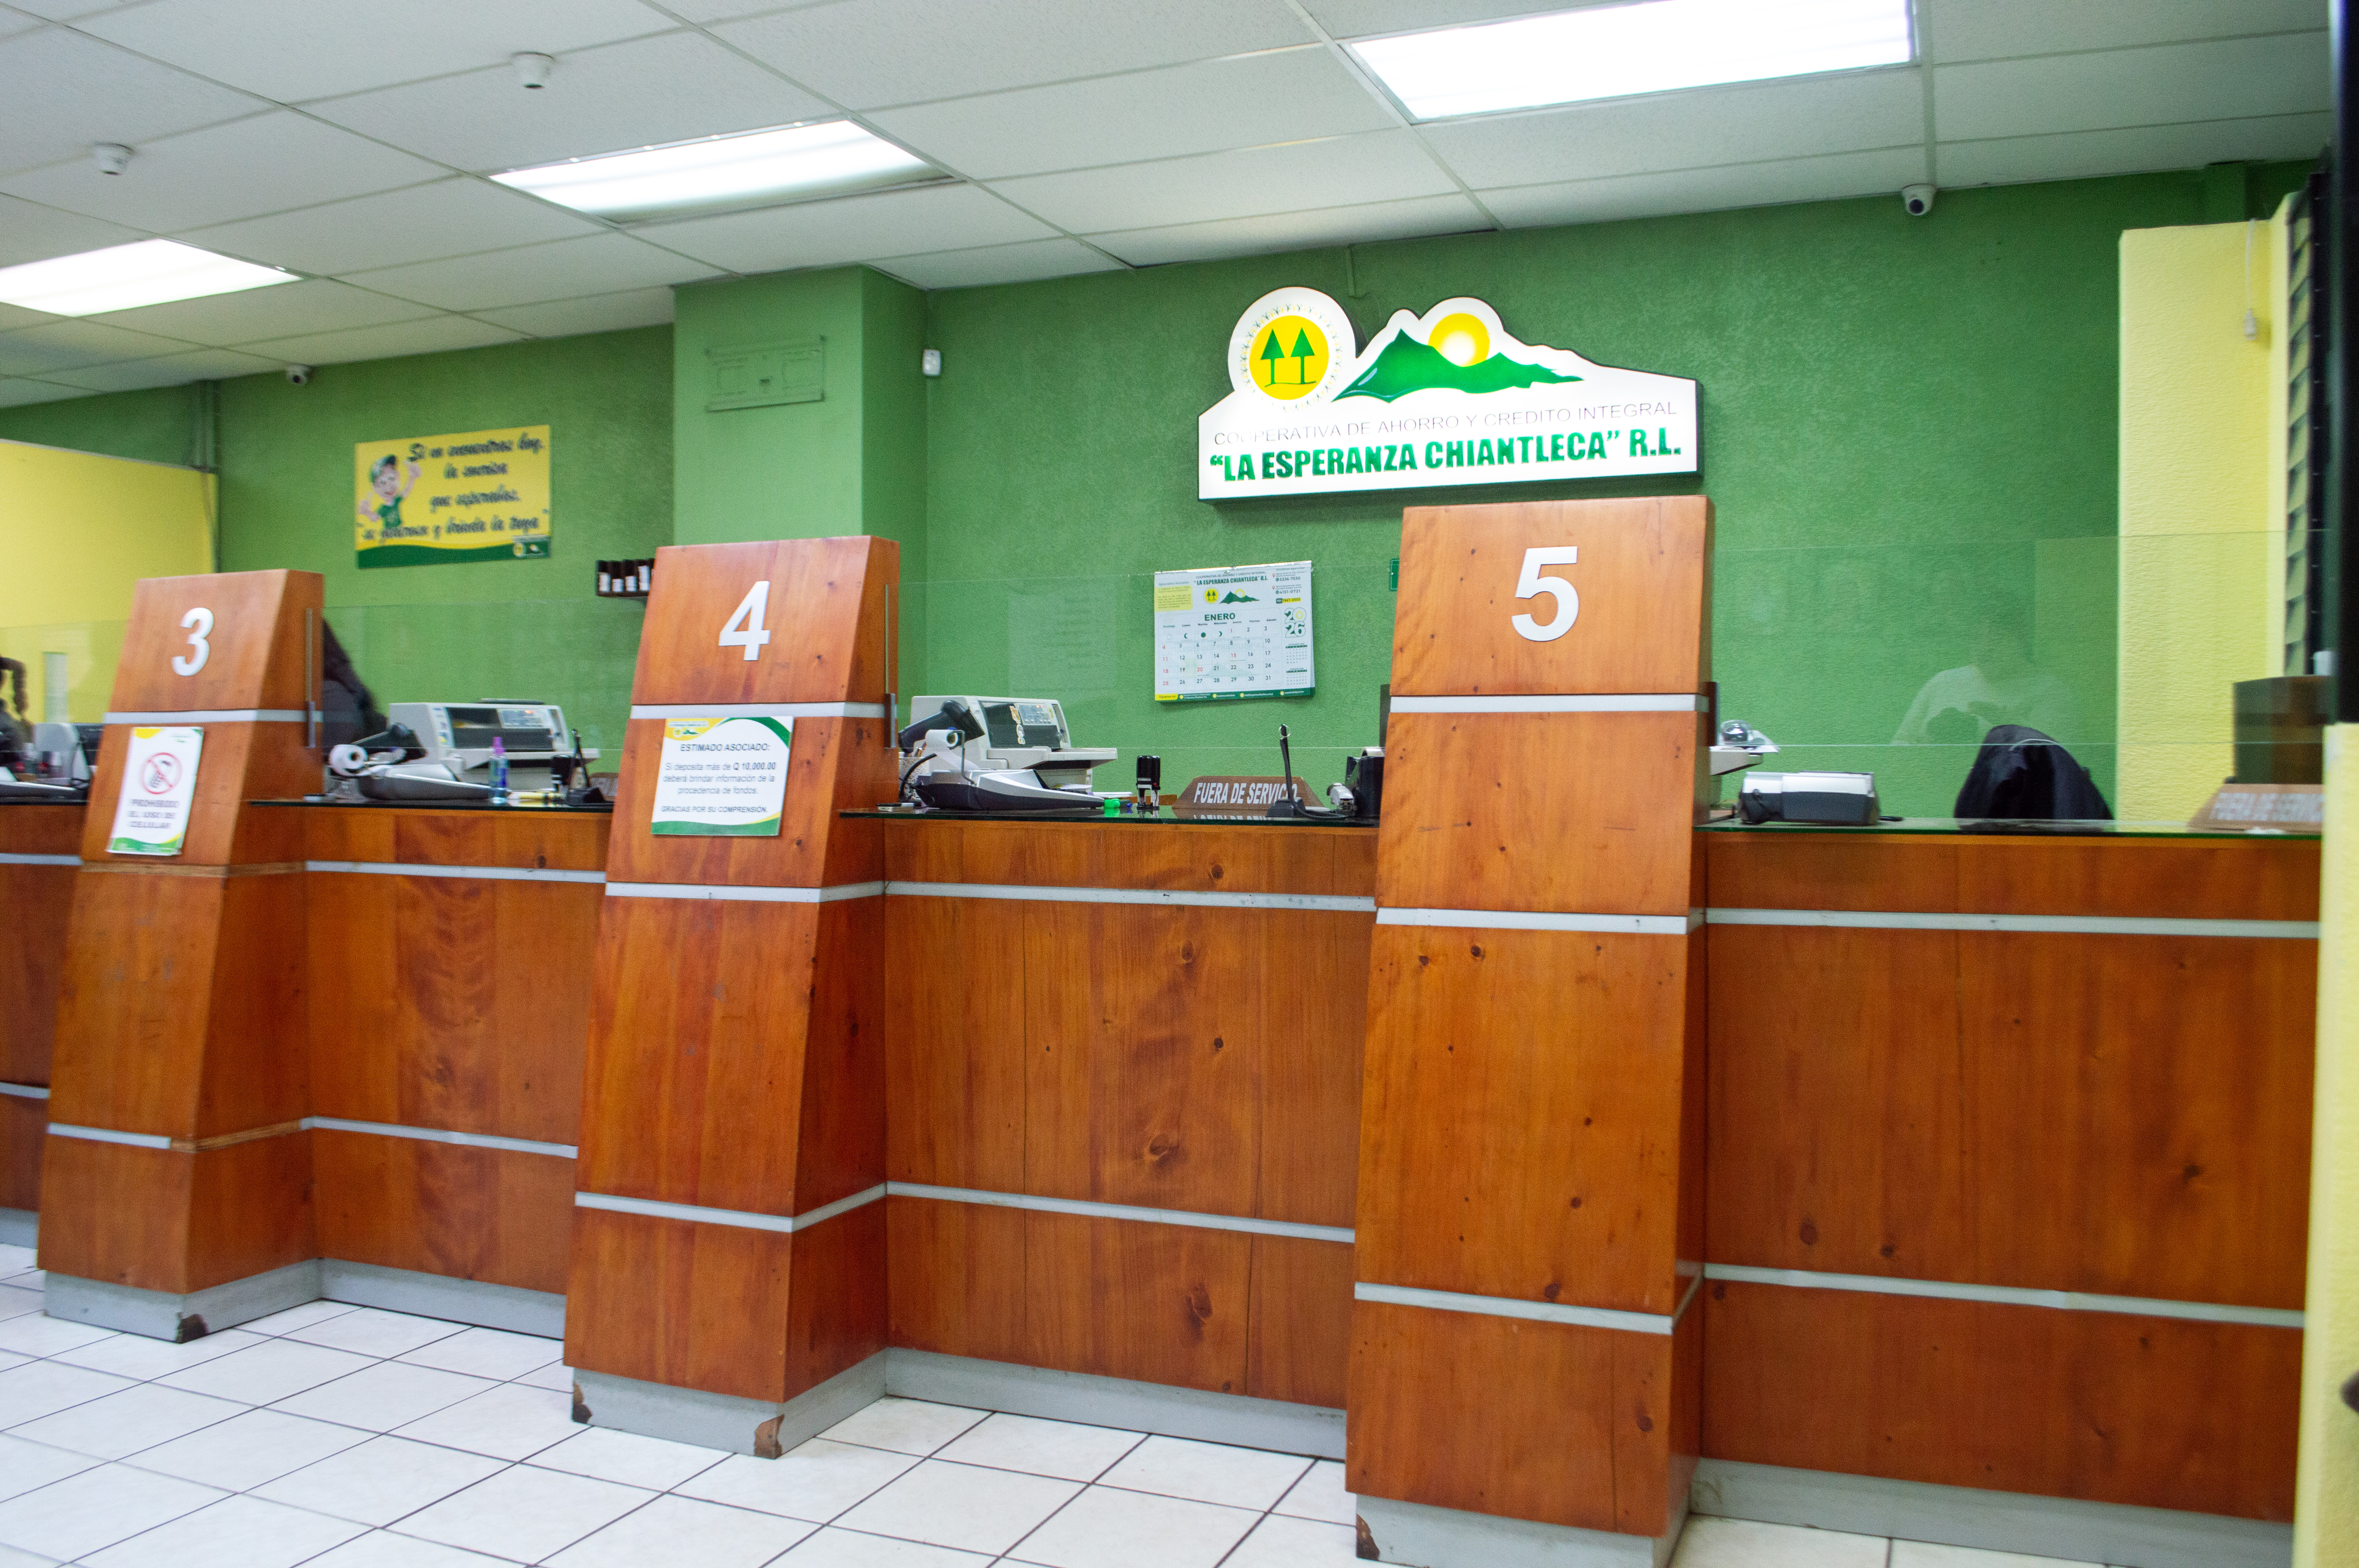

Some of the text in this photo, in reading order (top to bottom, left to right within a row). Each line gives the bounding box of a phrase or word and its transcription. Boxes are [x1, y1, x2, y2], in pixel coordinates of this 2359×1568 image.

[1215, 401, 1677, 445] COOPERATIVA DE AHORRO Y CREDITO INTEGRAL
[1262, 443, 1418, 479] ESPERANZA
[1425, 430, 1620, 469] CHIANTLECA”
[1629, 427, 1681, 458] R.L.
[1512, 546, 1579, 641] 5
[172, 608, 214, 676] 3
[718, 581, 770, 661] 4
[674, 763, 703, 771] deposita
[733, 762, 739, 771] Q
[678, 787, 720, 795] procedencia
[1194, 782, 1298, 804] FUERA DE SERVICO
